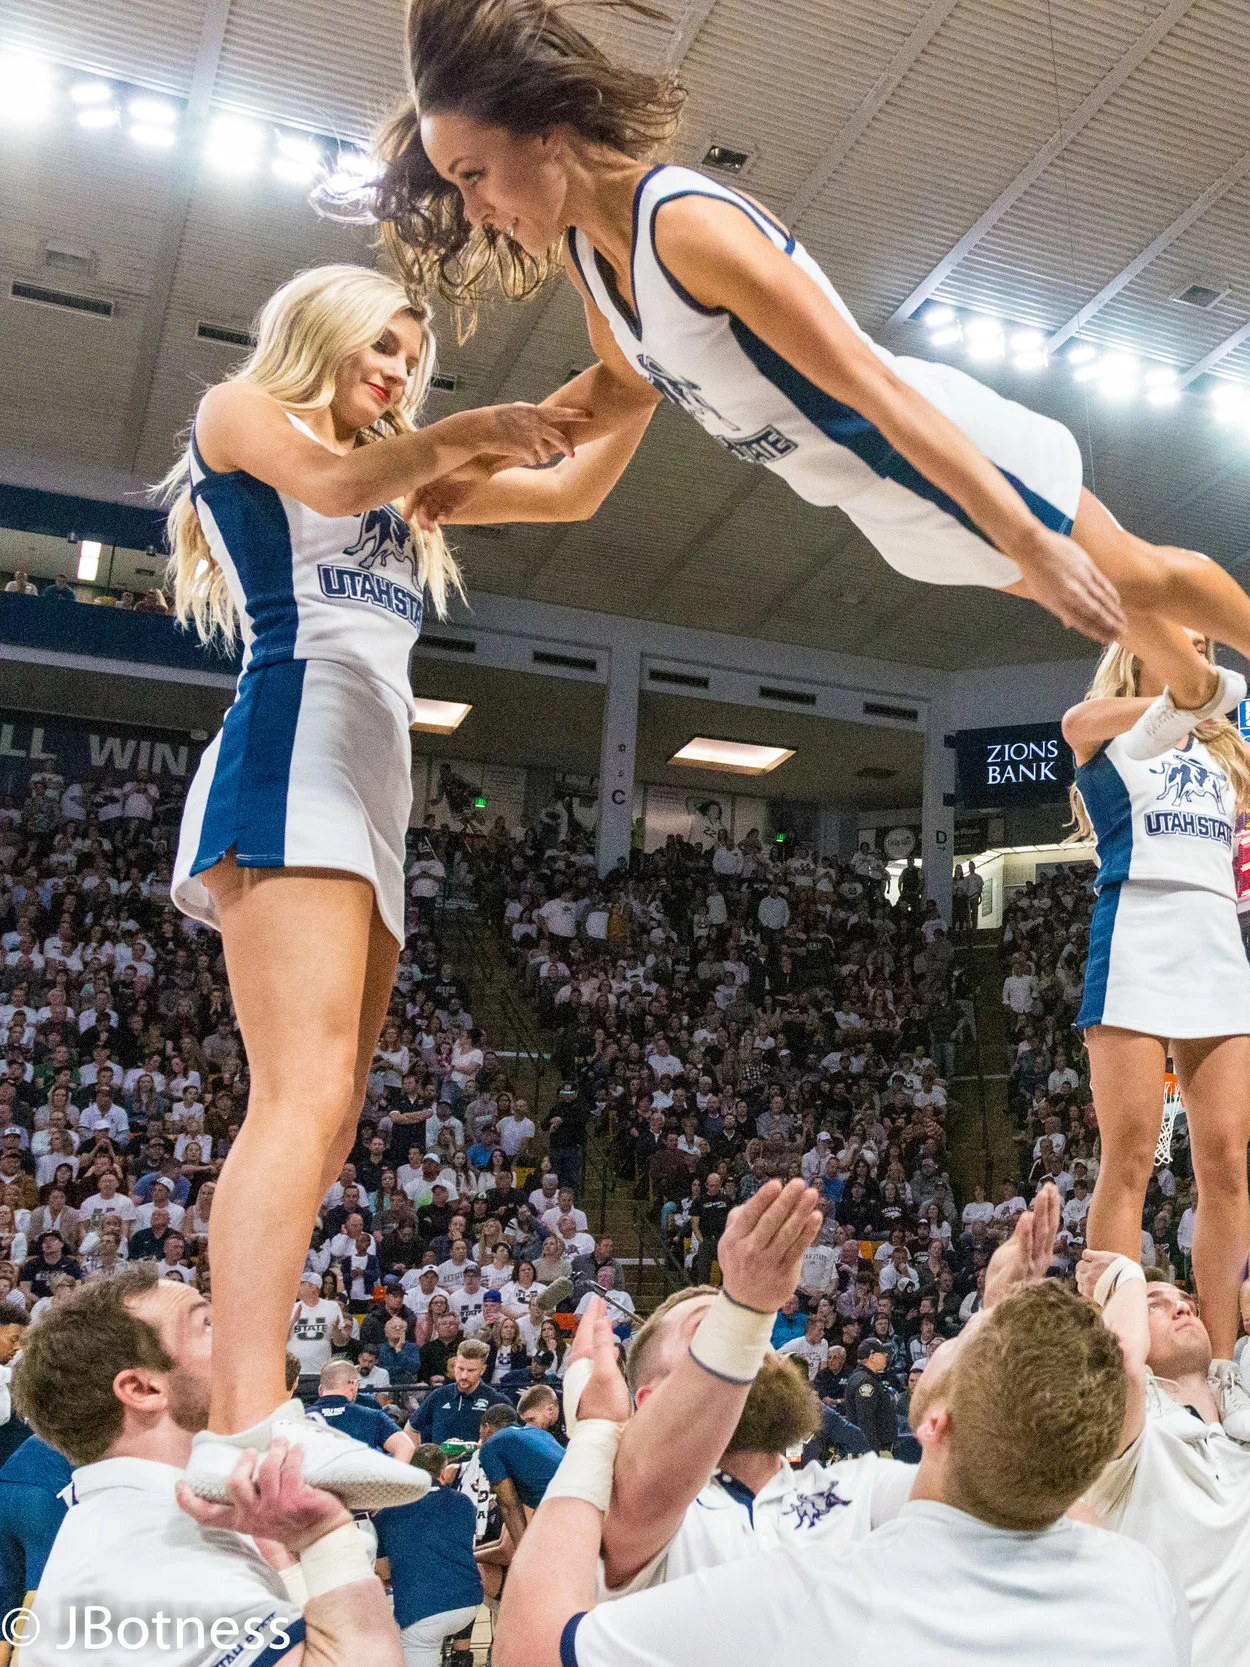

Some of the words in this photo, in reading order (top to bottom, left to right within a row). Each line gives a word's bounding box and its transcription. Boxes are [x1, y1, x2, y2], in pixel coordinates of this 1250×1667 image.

[318, 564, 395, 612] UTAH
[89, 734, 189, 776] WIN
[986, 740, 1058, 763] ZIONS
[986, 762, 1058, 785] BANK
[611, 789, 626, 805] C
[1144, 810, 1198, 836] UTAH
[936, 830, 947, 844] D
[293, 1324, 328, 1333] STATE
